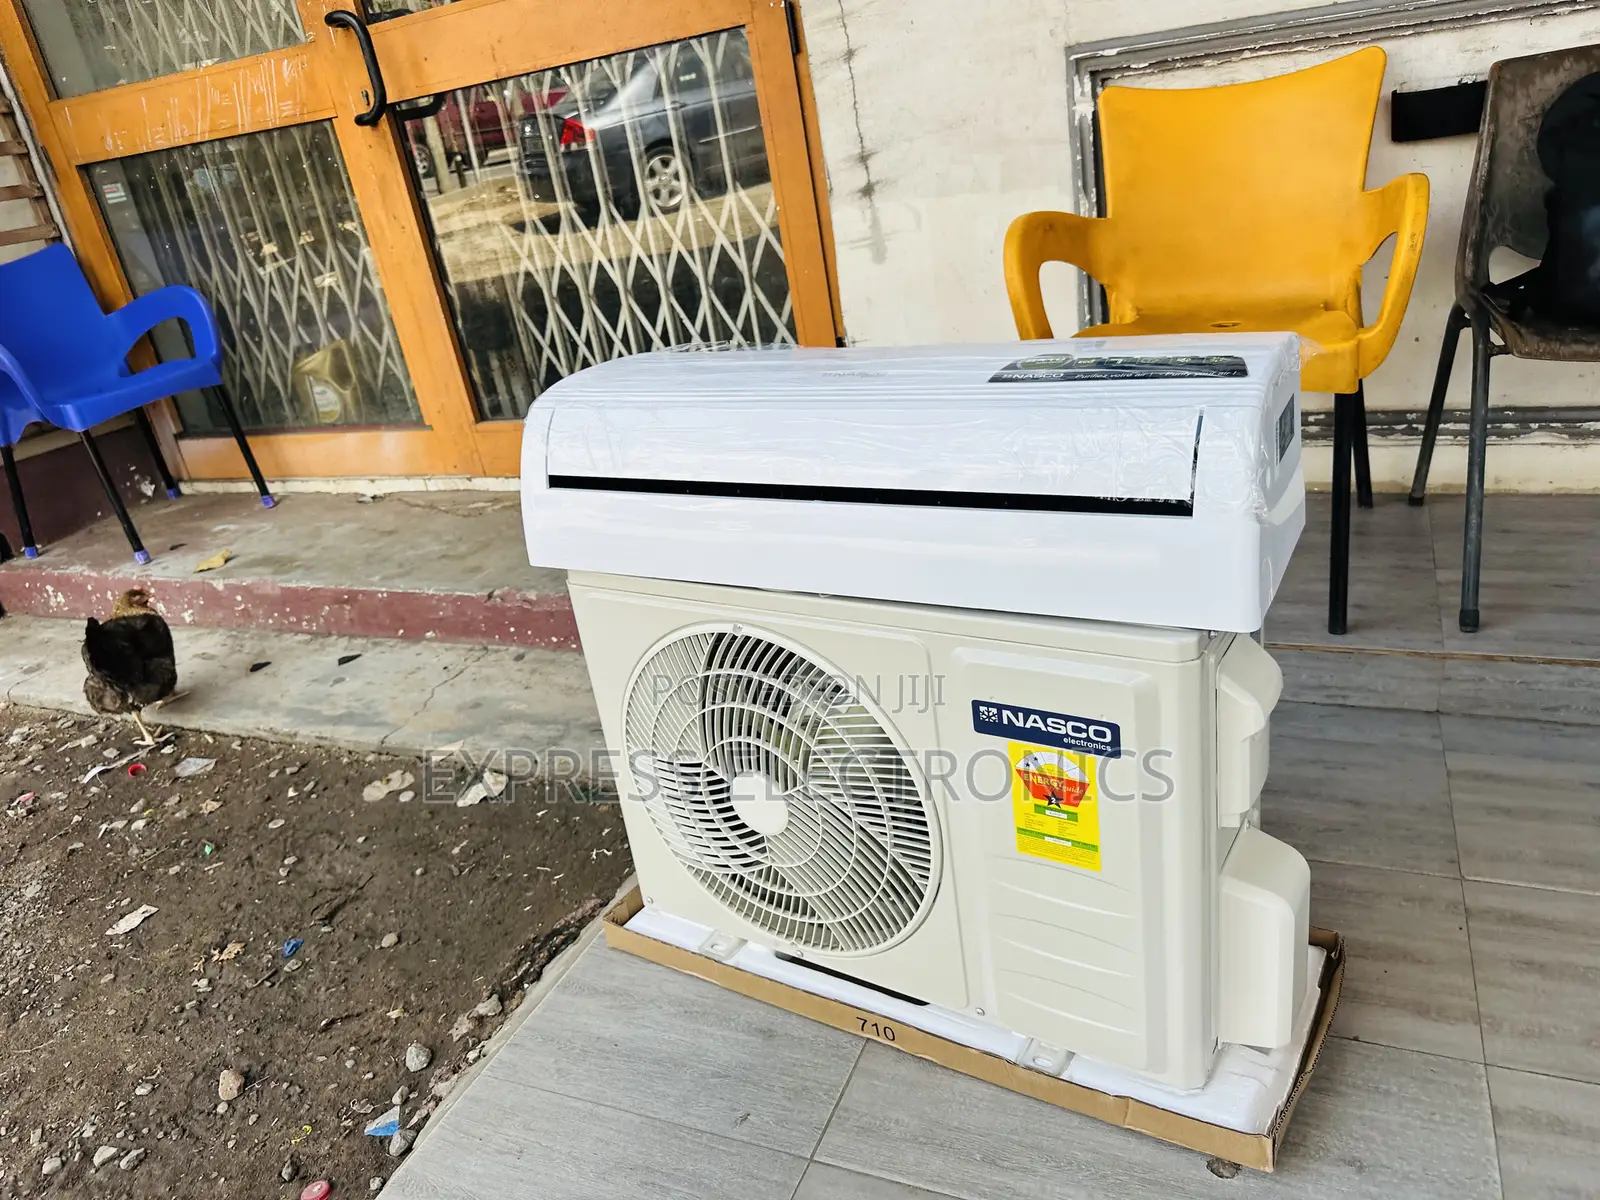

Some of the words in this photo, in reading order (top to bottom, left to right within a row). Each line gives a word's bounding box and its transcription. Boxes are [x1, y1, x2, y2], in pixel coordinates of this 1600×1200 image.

[1002, 709, 1112, 743] NASCO
[1063, 736, 1112, 752] electronics
[1023, 773, 1064, 790] ENERGY
[1062, 784, 1084, 795] guide
[855, 1016, 896, 1042] 710
